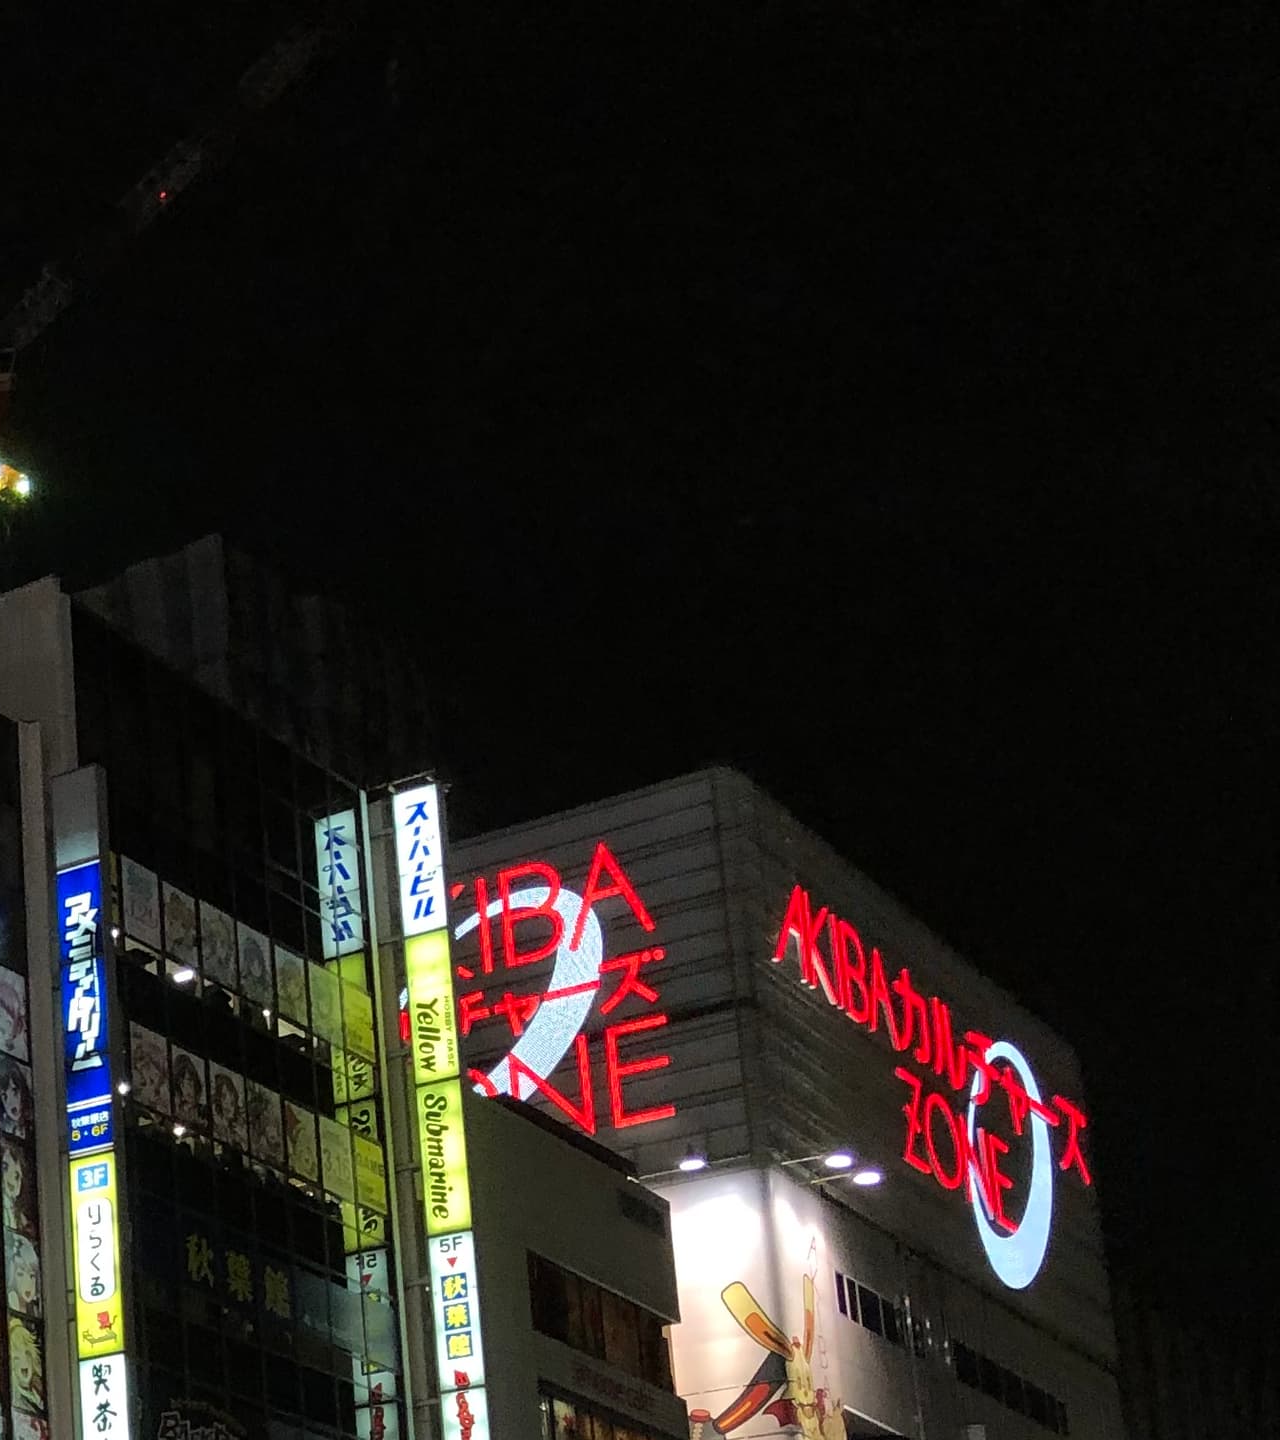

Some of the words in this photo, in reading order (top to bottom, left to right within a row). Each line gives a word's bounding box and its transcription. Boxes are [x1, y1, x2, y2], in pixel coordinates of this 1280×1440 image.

[403, 800, 436, 920] スーパービル
[452, 841, 656, 979] IBA
[415, 996, 438, 1073] Yellow
[81, 1168, 107, 1190] 3F
[423, 1091, 449, 1220] Submarine
[86, 1202, 108, 1298] りらくる
[439, 1236, 463, 1253] 5F
